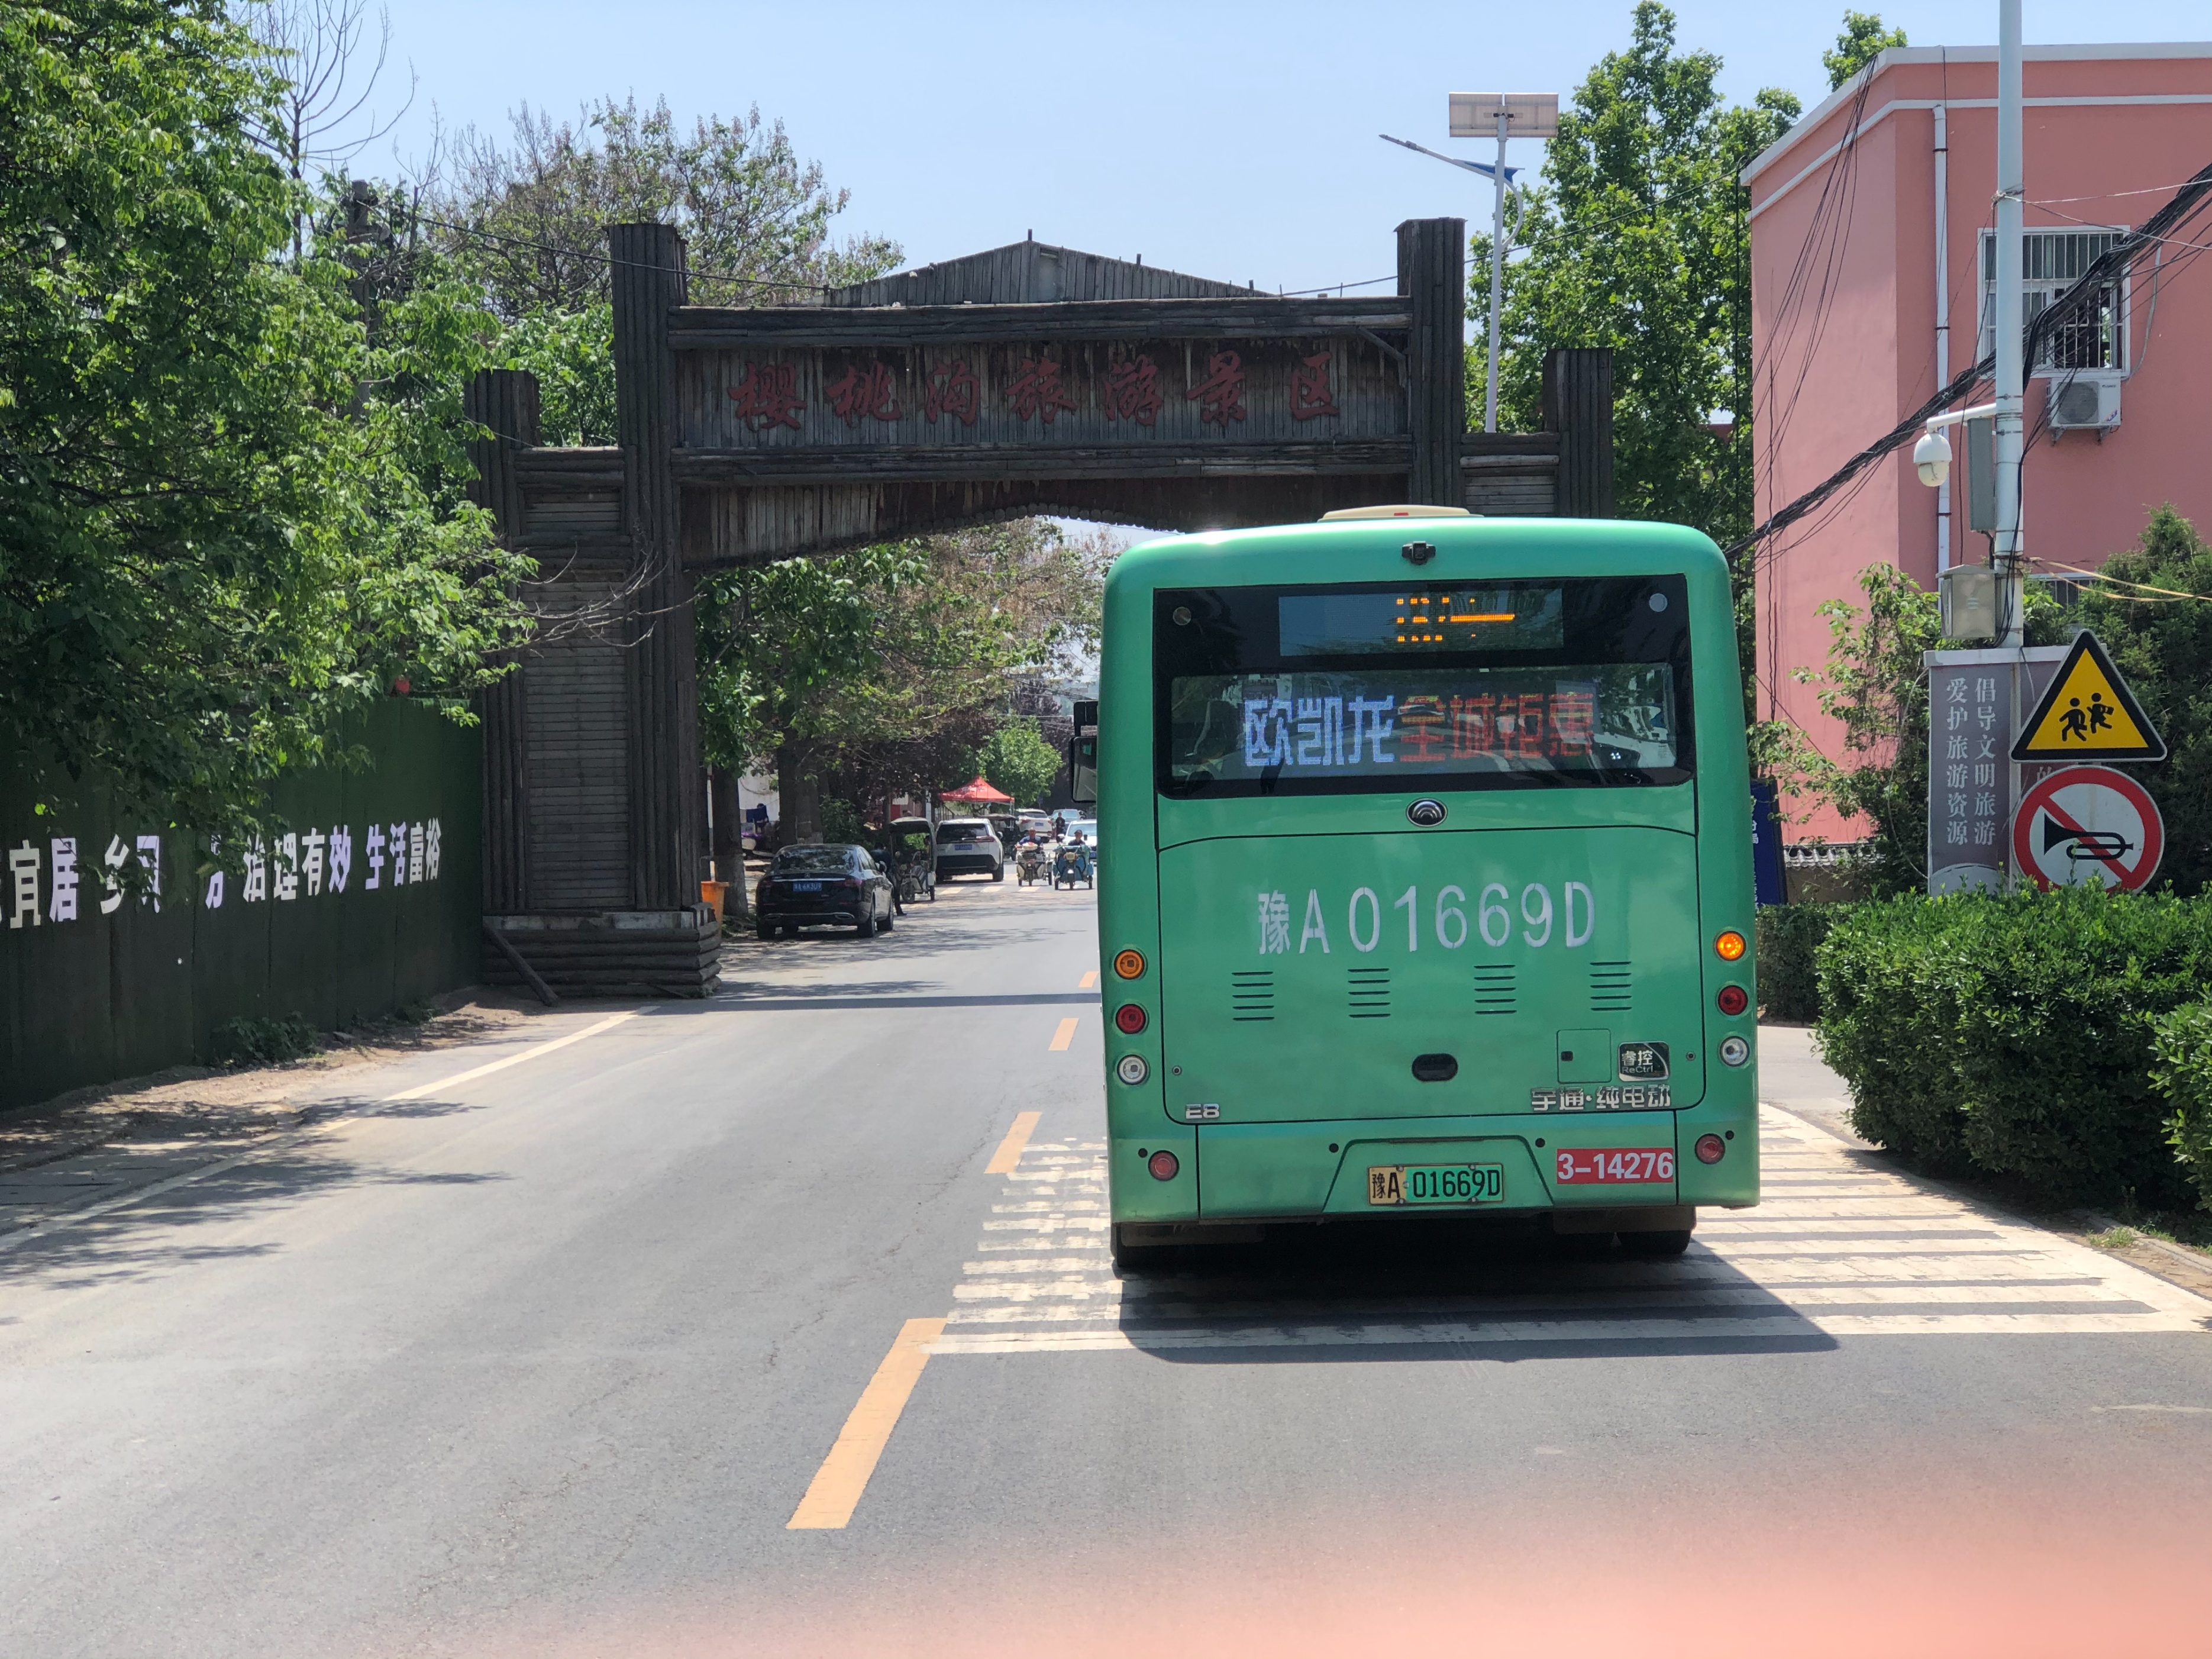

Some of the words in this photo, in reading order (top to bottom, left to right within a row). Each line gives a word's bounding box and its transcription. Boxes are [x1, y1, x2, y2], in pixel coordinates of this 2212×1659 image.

[727, 350, 1339, 432] 樱桃沟旅游景区
[1946, 677, 1968, 845] 爱护旅游资源
[1974, 677, 1996, 845] 倡导文明旅游
[366, 817, 441, 890] 生活富裕
[1258, 882, 1594, 954] 豫A01669D
[1622, 1050, 1653, 1066] 睿控
[1186, 1103, 1219, 1119] E8
[1558, 1152, 1673, 1180] 3-14276
